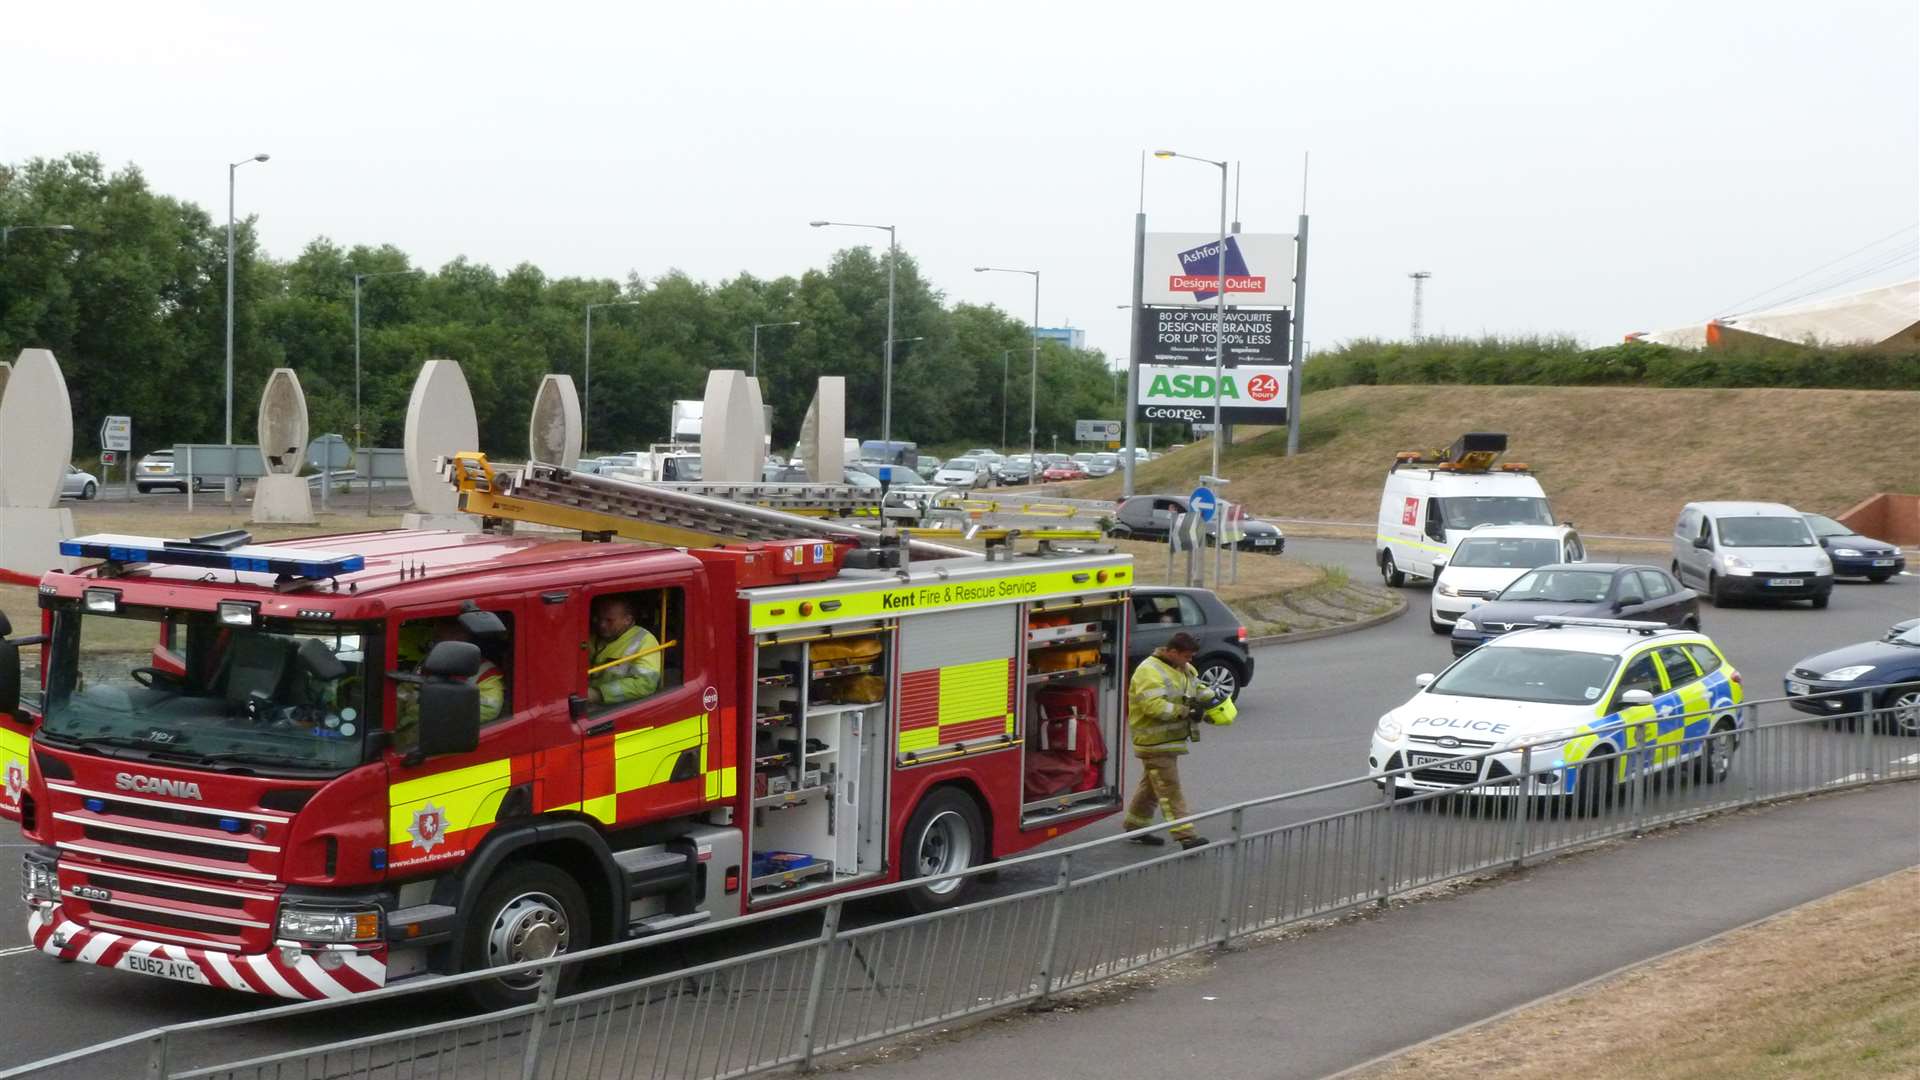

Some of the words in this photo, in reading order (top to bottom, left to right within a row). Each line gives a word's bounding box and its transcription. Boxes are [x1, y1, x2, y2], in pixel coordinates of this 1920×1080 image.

[1225, 278, 1262, 289] Outlet
[1159, 312, 1172, 321] 80
[1174, 312, 1188, 321] OF
[1190, 312, 1218, 321] YOUR
[1159, 322, 1218, 332] DESIGNER
[1222, 322, 1272, 333] BRANDS
[1159, 333, 1181, 343] FOR
[1184, 334, 1199, 344] UP
[1201, 334, 1217, 344] TO
[1247, 335, 1272, 345] LESS
[1147, 374, 1240, 399] ASDA
[1251, 378, 1276, 391] 24
[1252, 391, 1275, 399] hours
[882, 591, 915, 609] Kent
[919, 589, 941, 605] Fire
[944, 587, 952, 602] &
[955, 584, 996, 601] Rescue
[998, 580, 1037, 597] Service
[1412, 717, 1510, 735] POLICE
[115, 772, 203, 801] SCANIA
[129, 955, 166, 975] EU62
[168, 962, 196, 980] AYC
